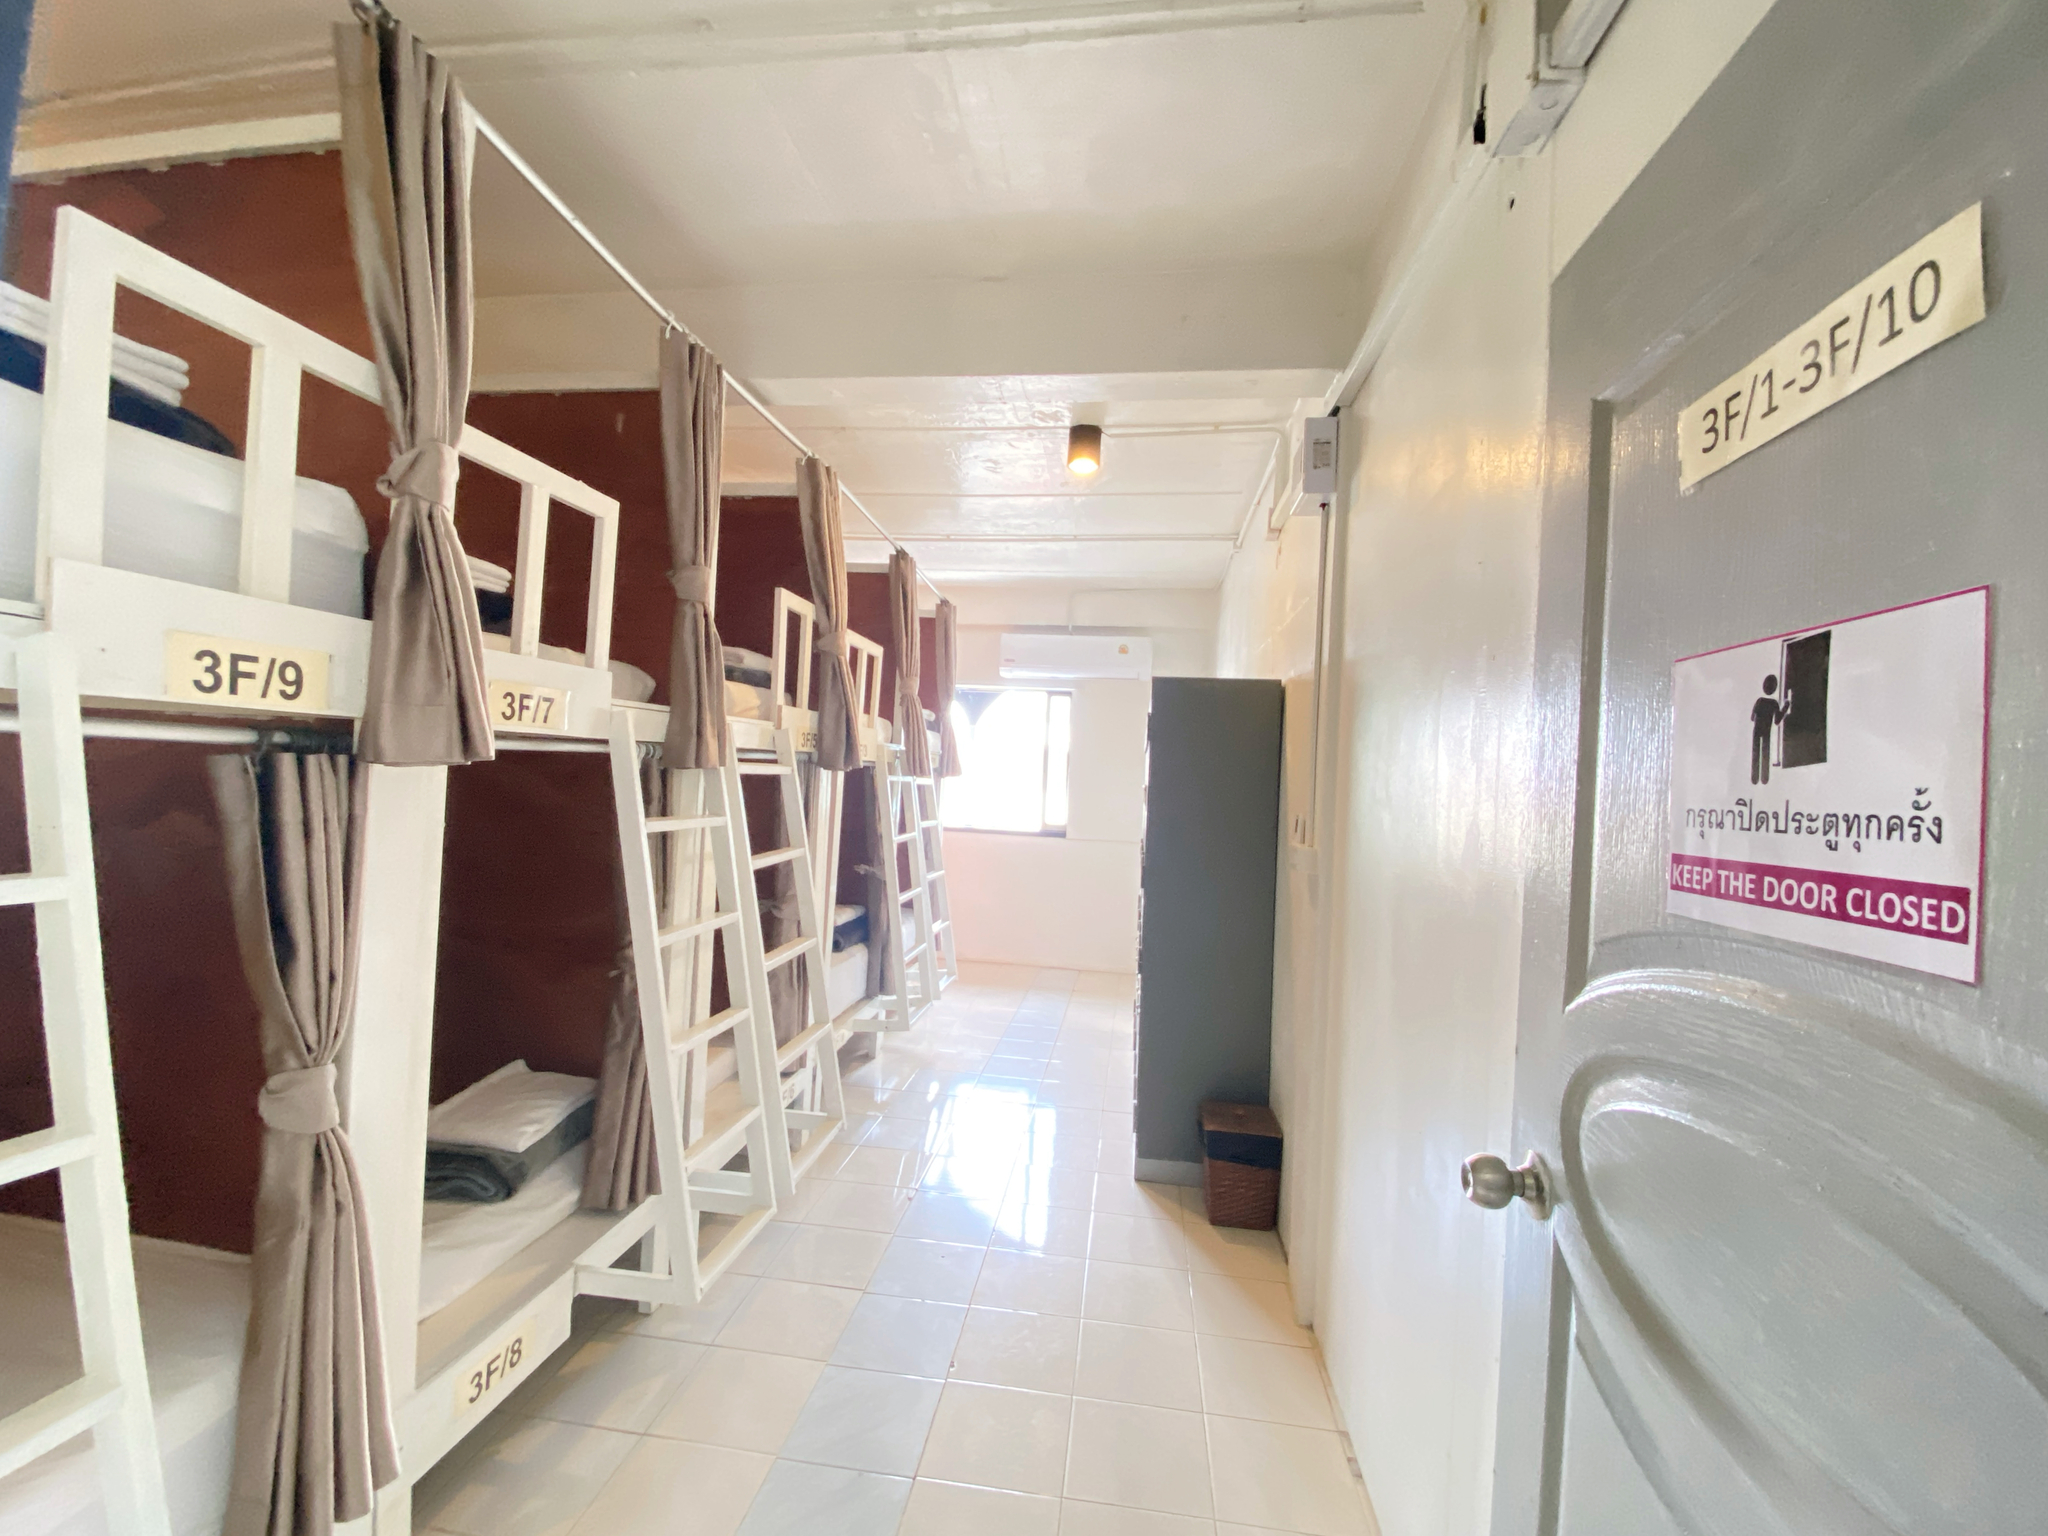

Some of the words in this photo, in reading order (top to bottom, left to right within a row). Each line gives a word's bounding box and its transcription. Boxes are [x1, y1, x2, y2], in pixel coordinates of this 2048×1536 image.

[1701, 259, 1941, 454] 3F/1-3F/10
[192, 649, 304, 701] 3F/9
[501, 691, 555, 724] 3F/7
[1685, 787, 1943, 852] กรุณาปิดประตูทุกครั้ง
[1671, 863, 1713, 891] KEEP
[1717, 869, 1757, 899] THE
[1763, 876, 1838, 913] DOOR
[1846, 887, 1966, 934] CLOSED
[468, 1336, 523, 1404] 3F/8
